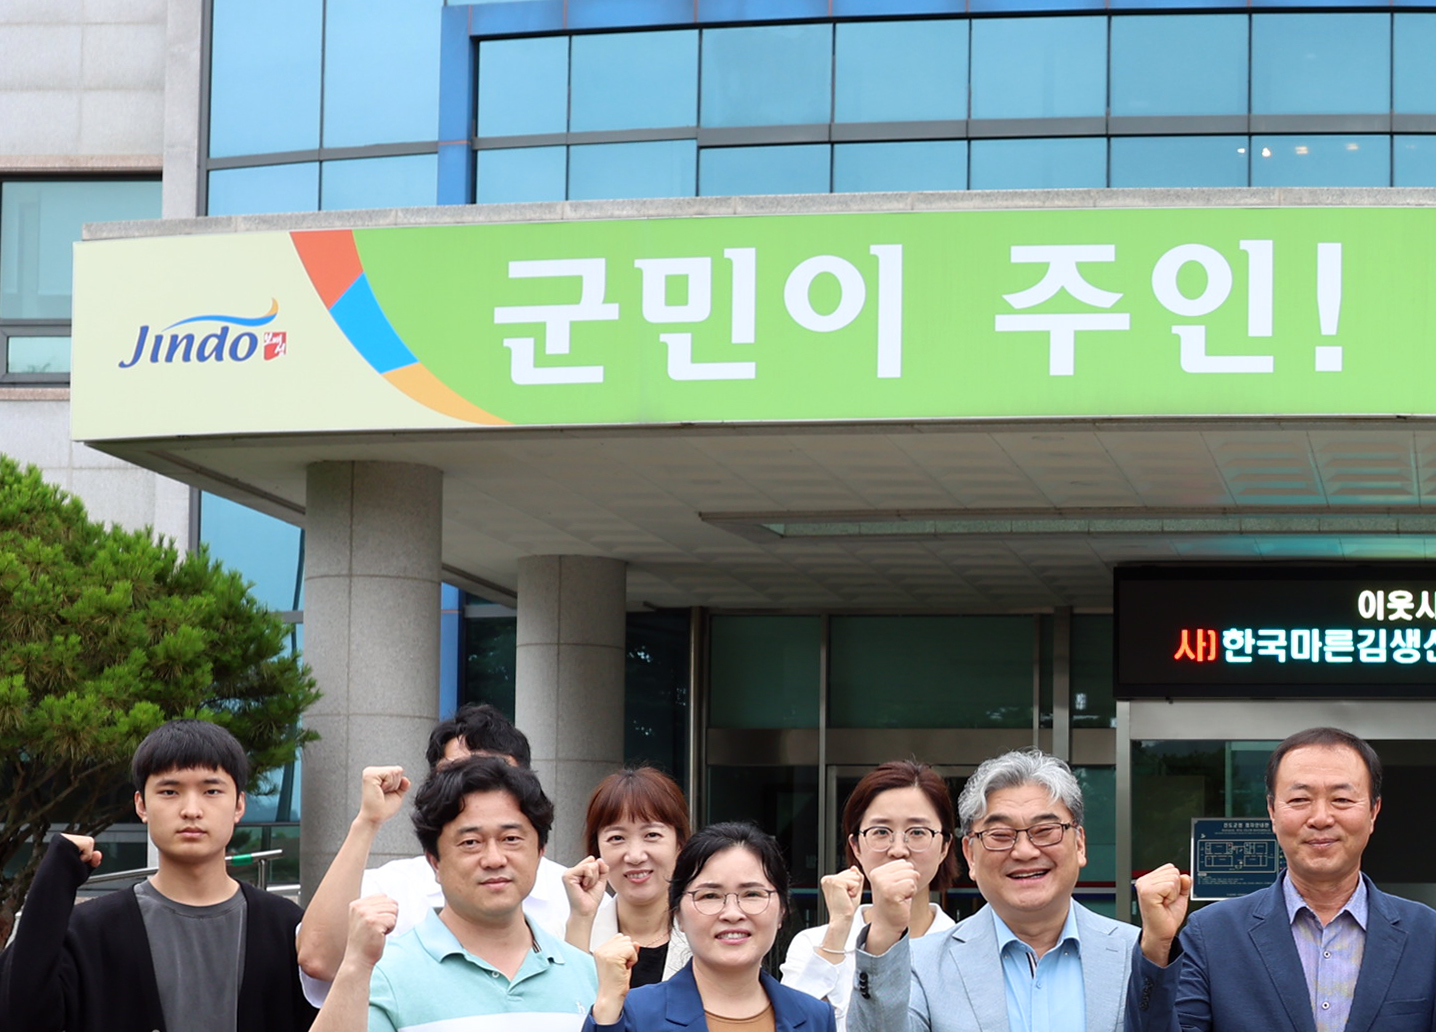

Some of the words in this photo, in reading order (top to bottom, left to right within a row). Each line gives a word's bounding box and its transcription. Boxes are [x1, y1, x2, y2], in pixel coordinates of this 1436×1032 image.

[118, 325, 258, 368] Jindo
[493, 243, 904, 387] 군민이
[994, 239, 1345, 376] 주인!
